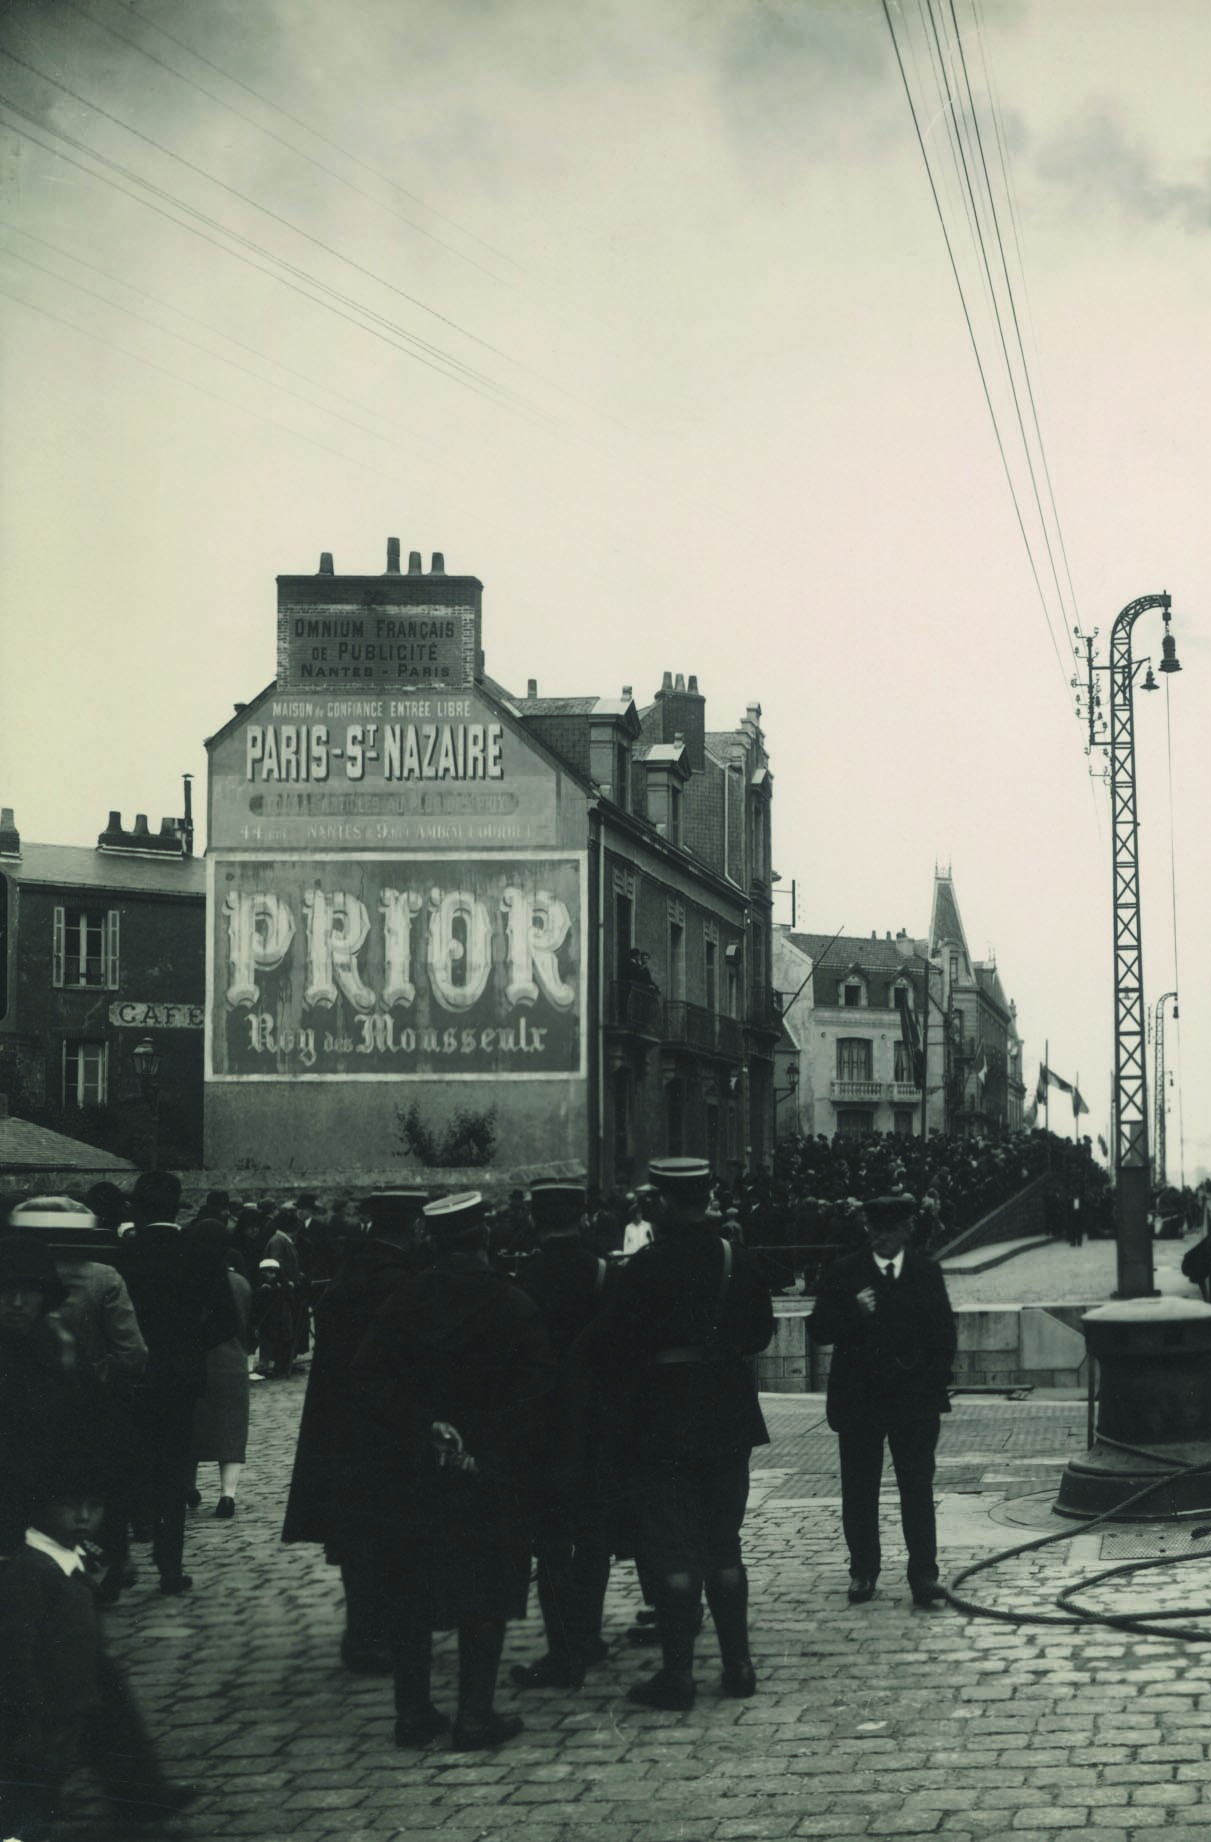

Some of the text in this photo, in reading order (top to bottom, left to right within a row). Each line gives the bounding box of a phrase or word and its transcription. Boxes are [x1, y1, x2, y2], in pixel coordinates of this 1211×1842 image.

[294, 618, 364, 639] OMNIUM
[338, 641, 438, 661] PUBLICITÉ
[300, 663, 373, 678] NANTES
[397, 663, 450, 678] PARIS
[272, 701, 313, 718] MAISON
[326, 701, 383, 717] CONFIANCE
[390, 698, 432, 717] ENTRÉE
[437, 701, 472, 717] LIBRE
[383, 723, 505, 782] NAZAIRE
[222, 886, 575, 1011] PRIOR
[244, 1012, 316, 1066] Roy
